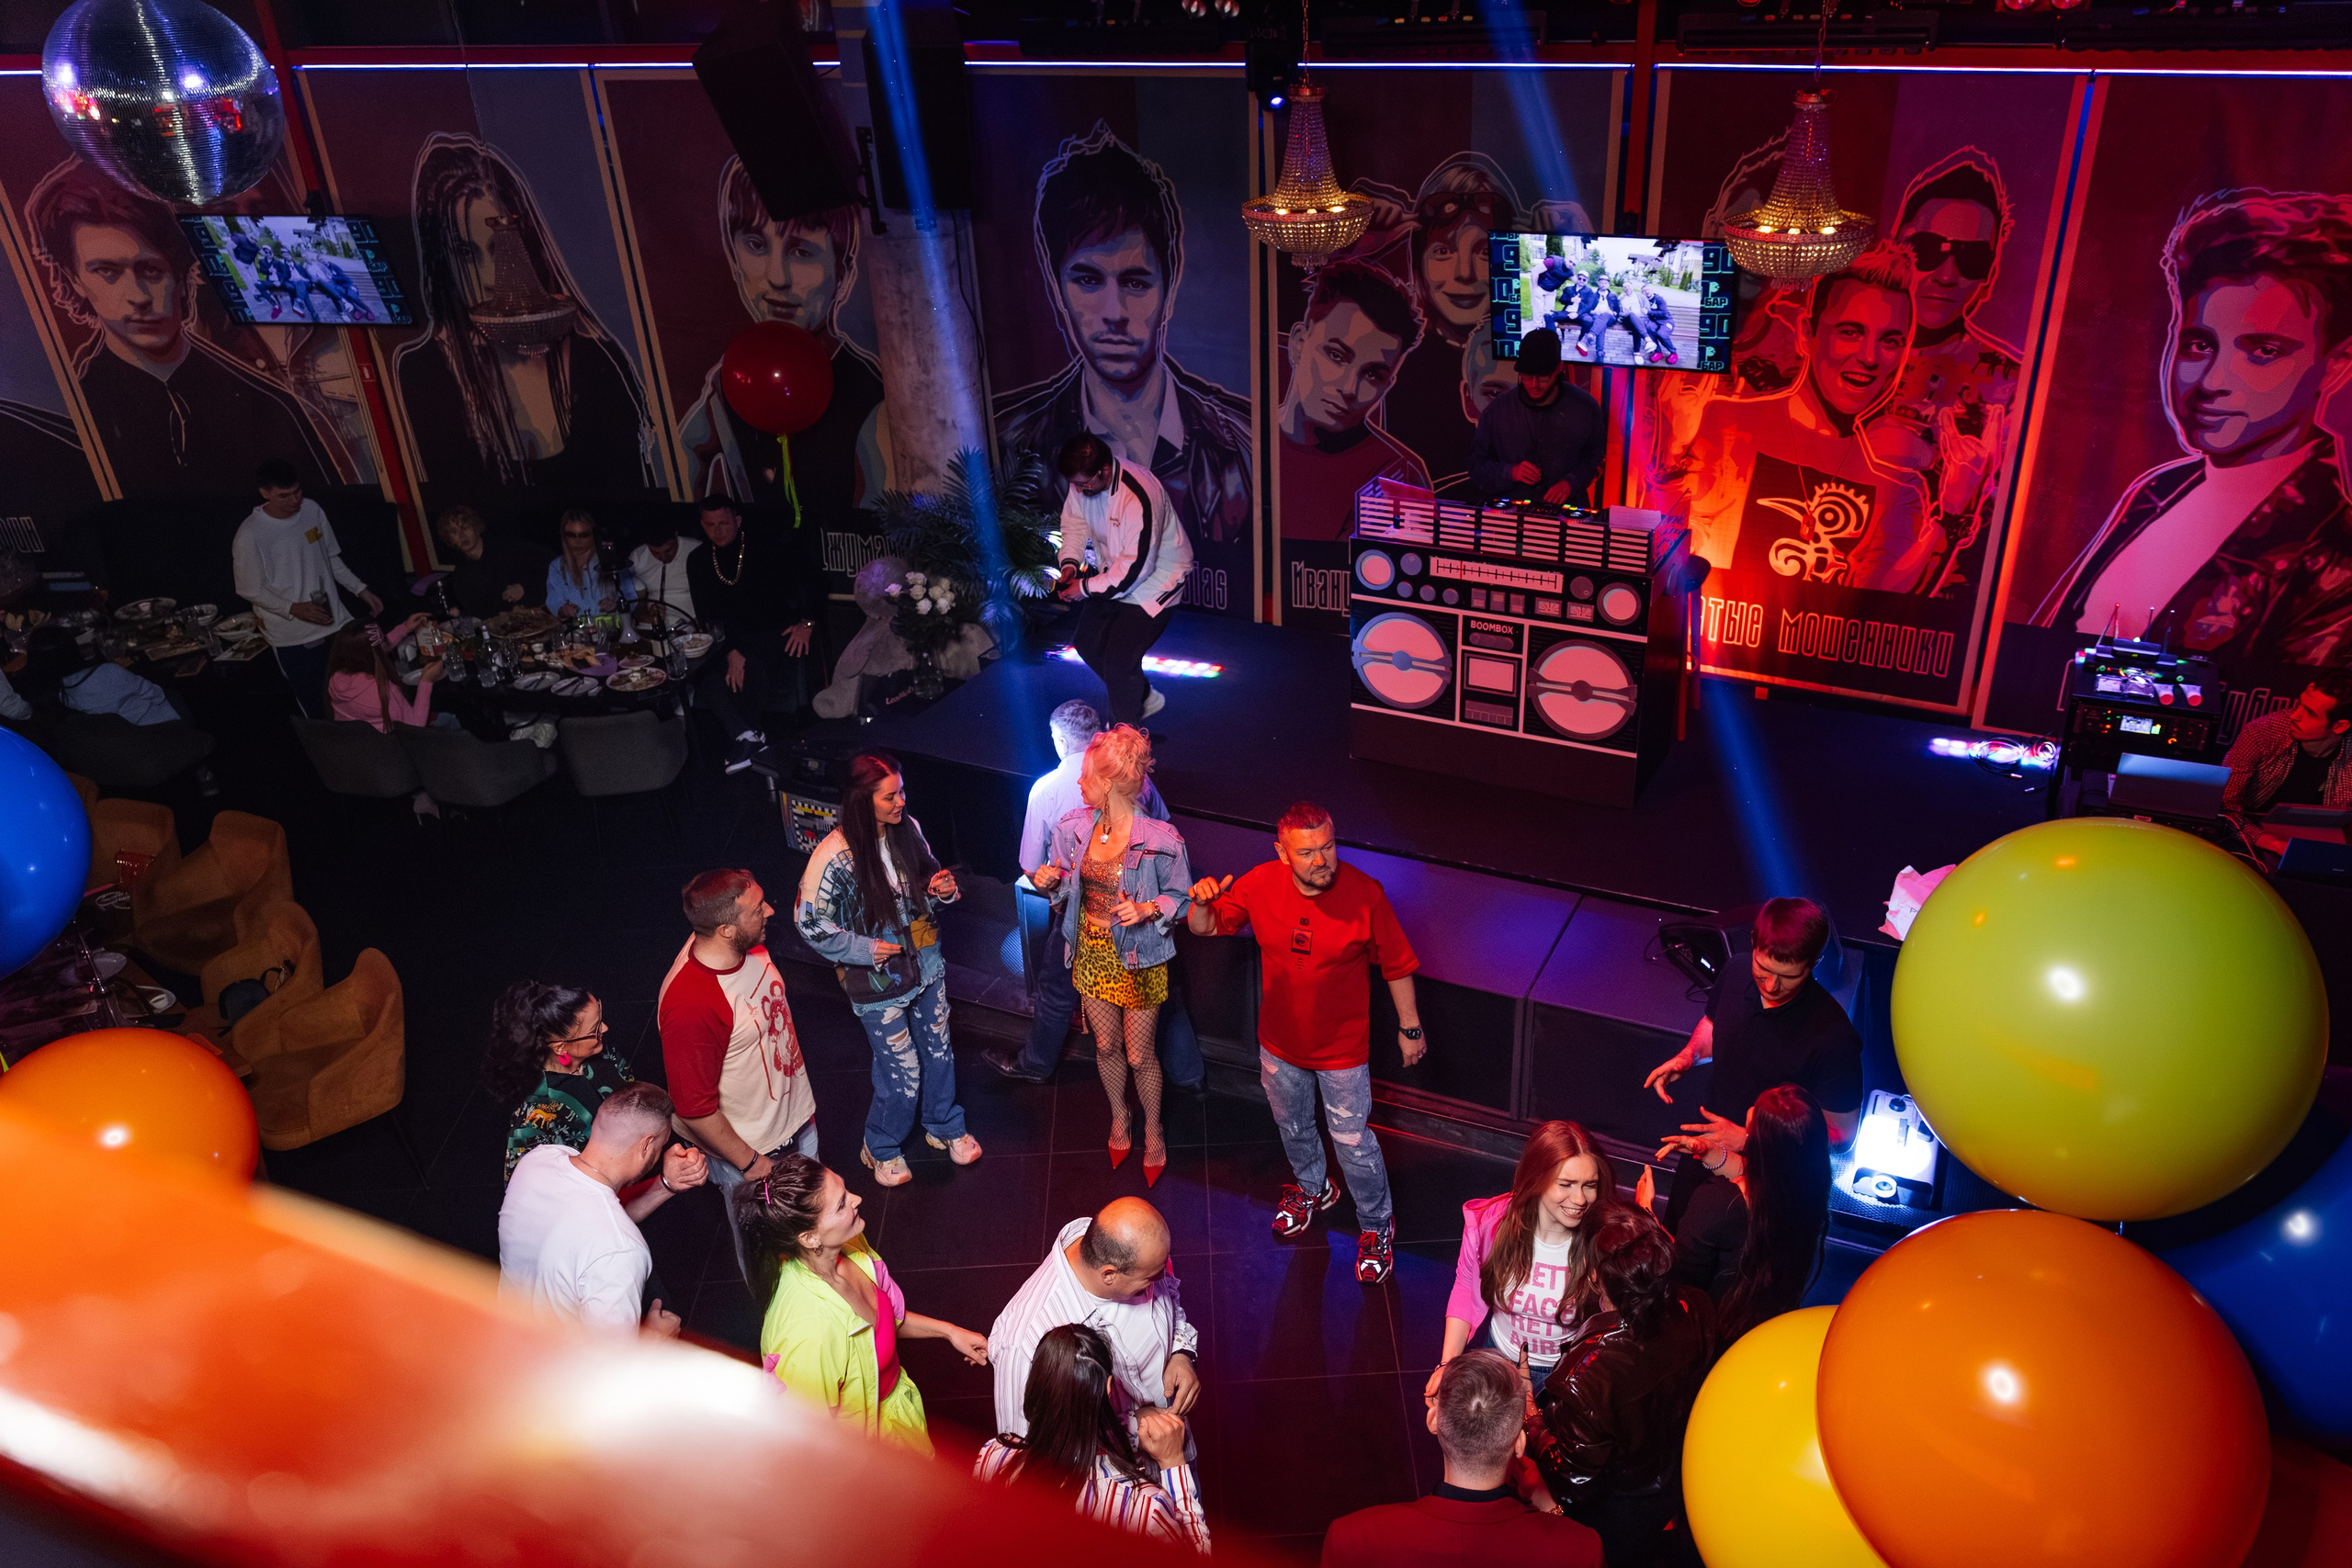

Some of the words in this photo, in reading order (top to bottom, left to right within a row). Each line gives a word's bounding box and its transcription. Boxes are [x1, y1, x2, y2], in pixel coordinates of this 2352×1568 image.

[1704, 297, 1728, 308] БАР
[1470, 619, 1514, 635] BOOMBOX
[1701, 595, 1764, 649] тые
